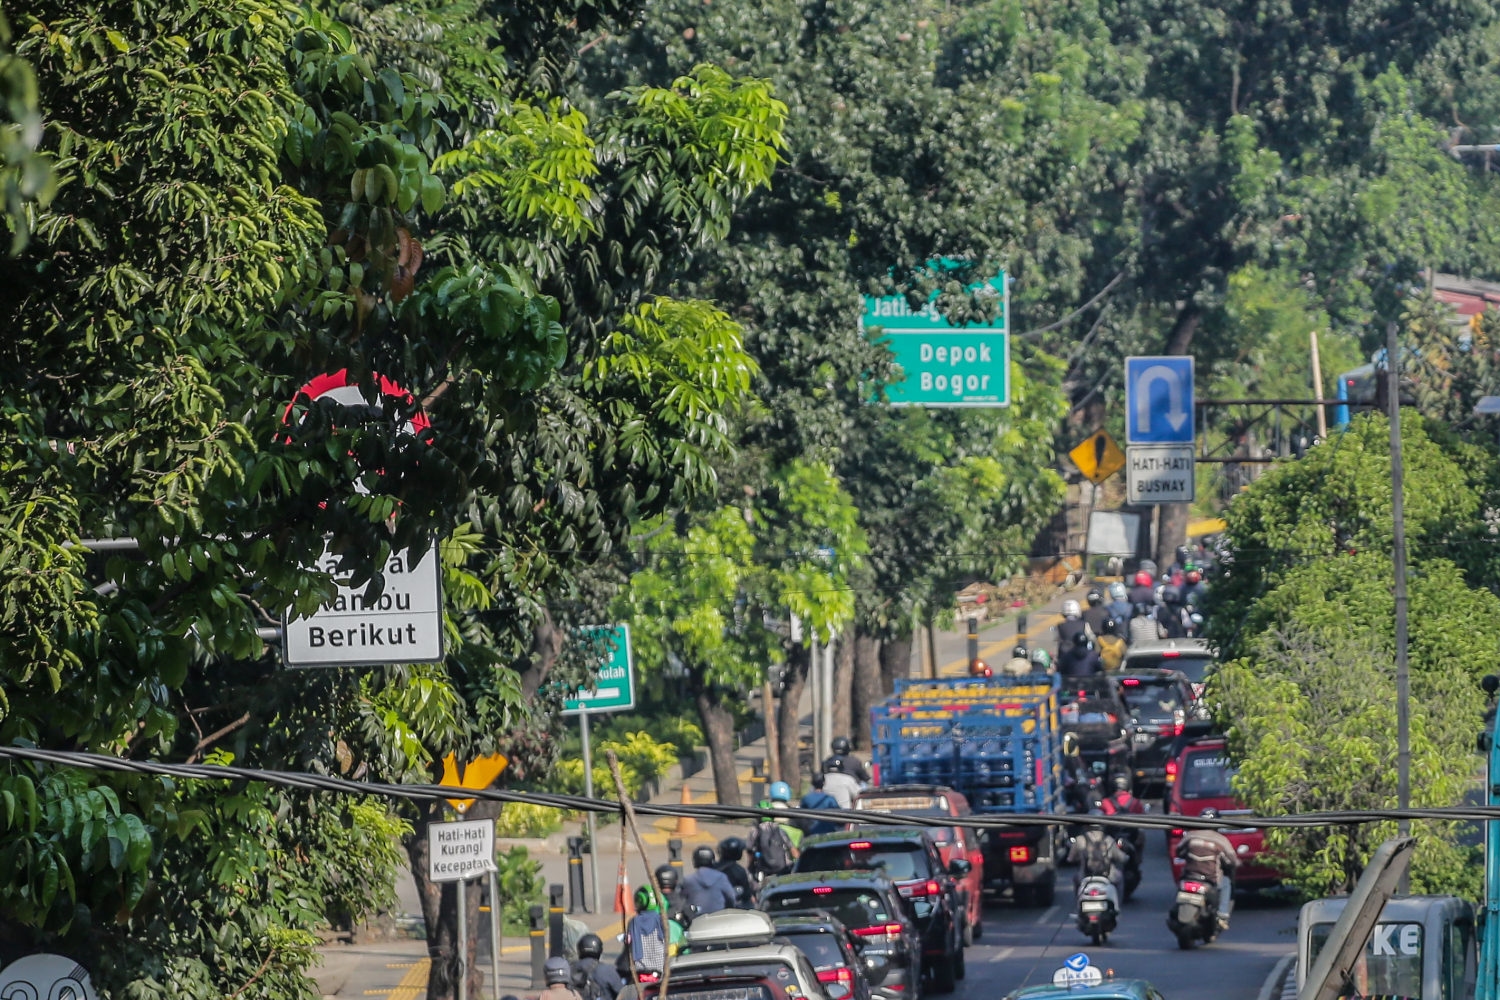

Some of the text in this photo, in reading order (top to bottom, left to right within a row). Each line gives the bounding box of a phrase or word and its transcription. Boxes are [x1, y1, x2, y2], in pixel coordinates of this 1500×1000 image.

[920, 342, 991, 366] Depok
[920, 372, 990, 396] Bogor
[1133, 457, 1190, 470] HATI-HATI
[1137, 480, 1185, 492] BUSWAY
[322, 592, 410, 613] ambu
[309, 622, 417, 648] Berikut
[438, 827, 485, 842] Hati-Hati
[441, 843, 482, 855] Kurangi
[433, 859, 489, 873] Kecepatan
[1373, 924, 1418, 956] KE
